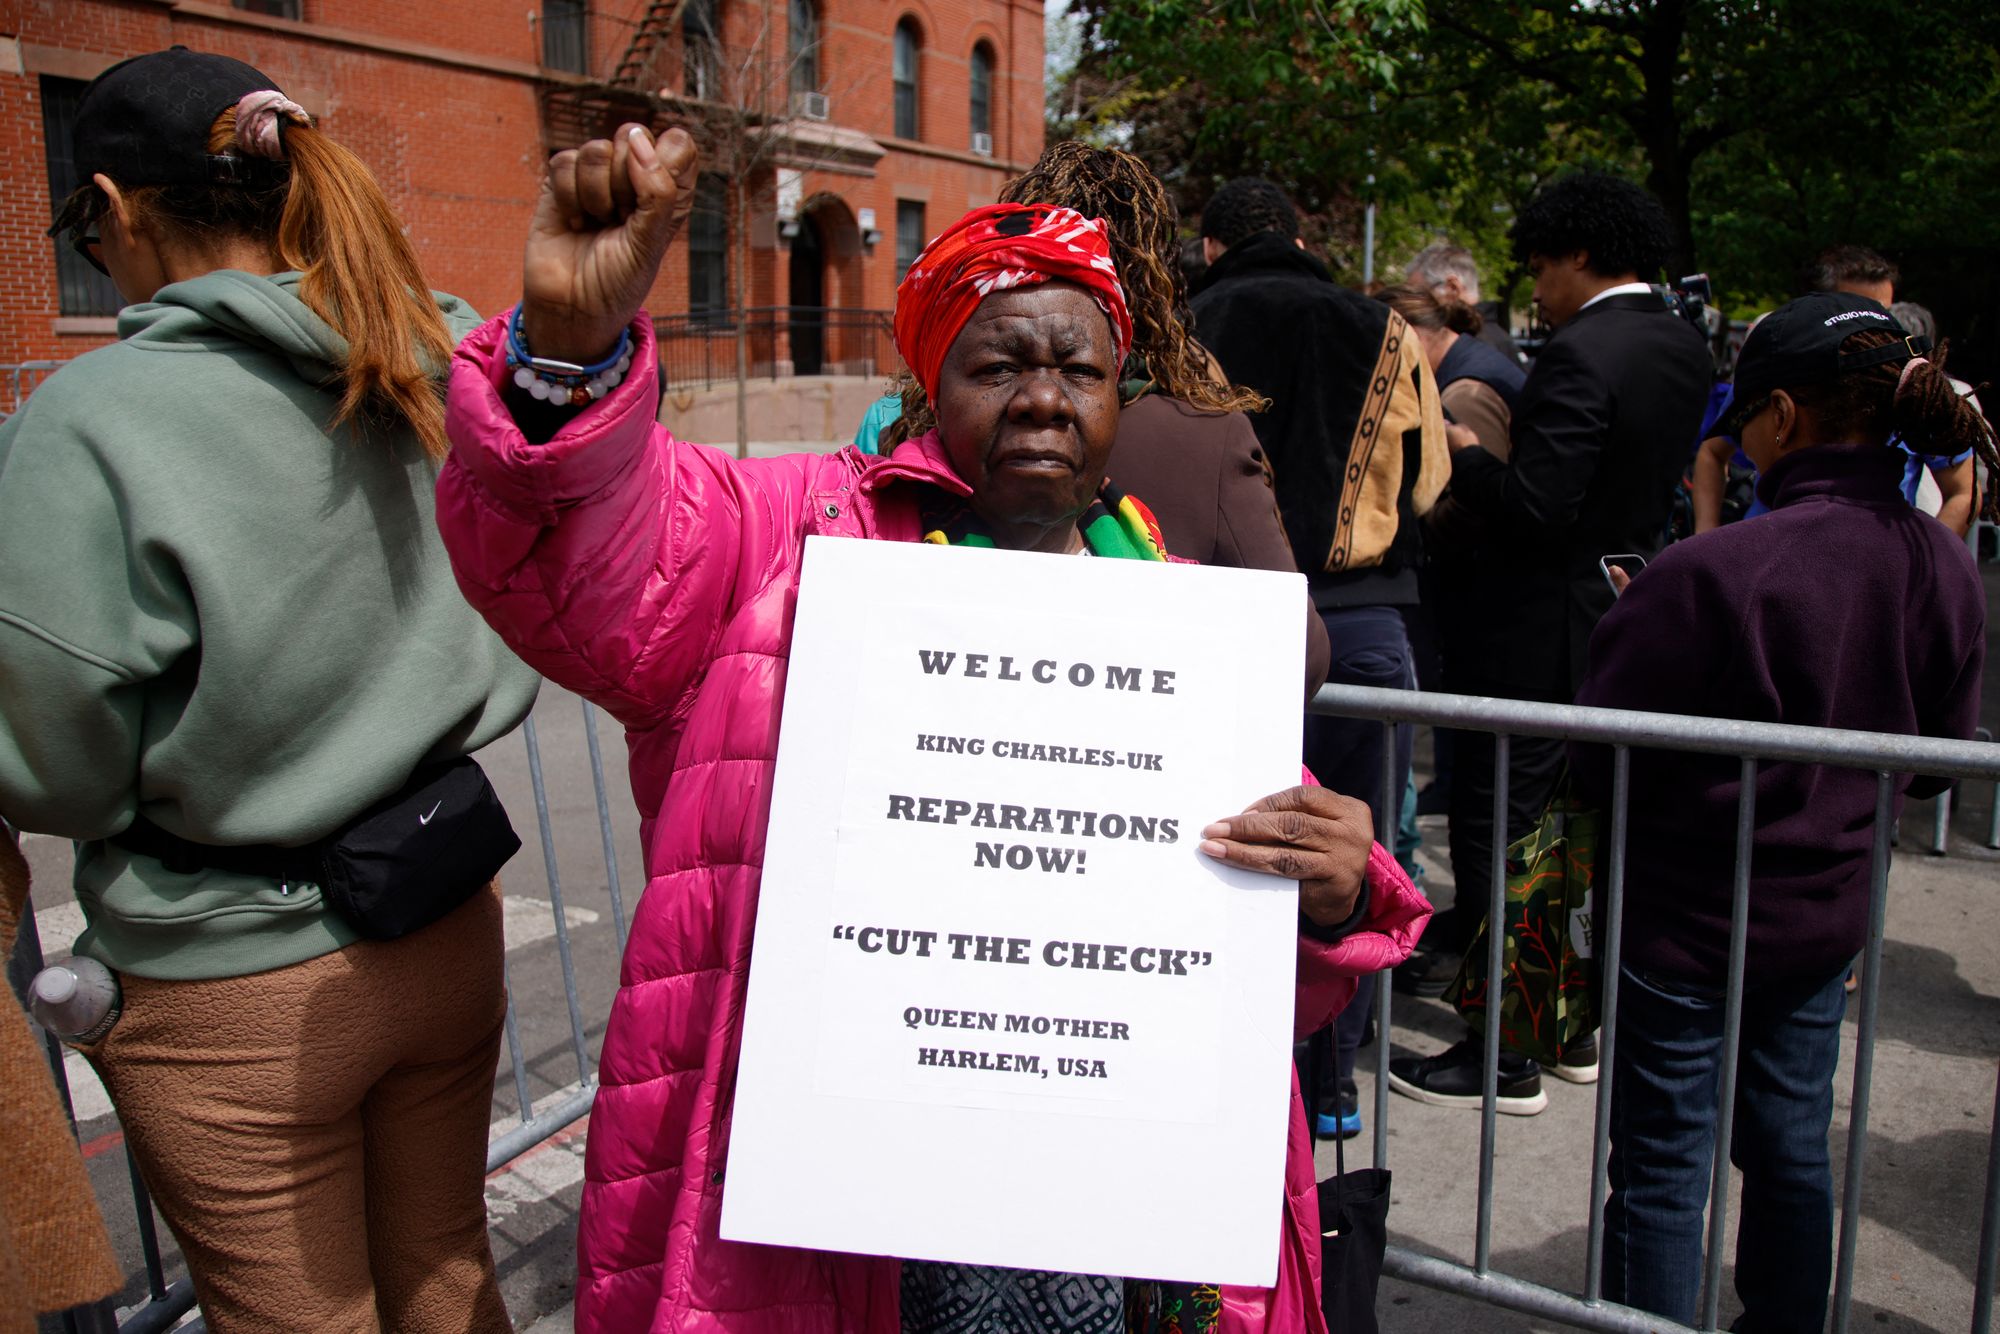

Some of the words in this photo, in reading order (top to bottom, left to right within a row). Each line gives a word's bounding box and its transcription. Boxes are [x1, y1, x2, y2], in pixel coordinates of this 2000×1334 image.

[1824, 311, 1859, 326] STUDIO
[919, 650, 1176, 694] WELCOME
[917, 735, 985, 757] KING
[993, 741, 1163, 771] CHARLES-UK
[887, 795, 1179, 844] REPARATIONS
[974, 842, 1086, 874] NOW!
[833, 925, 938, 957] “CUT
[948, 934, 1031, 964] THE
[1043, 941, 1212, 975] CHECK”
[904, 1007, 998, 1036] QUEEN
[1005, 1015, 1130, 1040] MOTHER
[918, 1048, 1048, 1078] HARLEM,
[1058, 1058, 1108, 1079] USA
